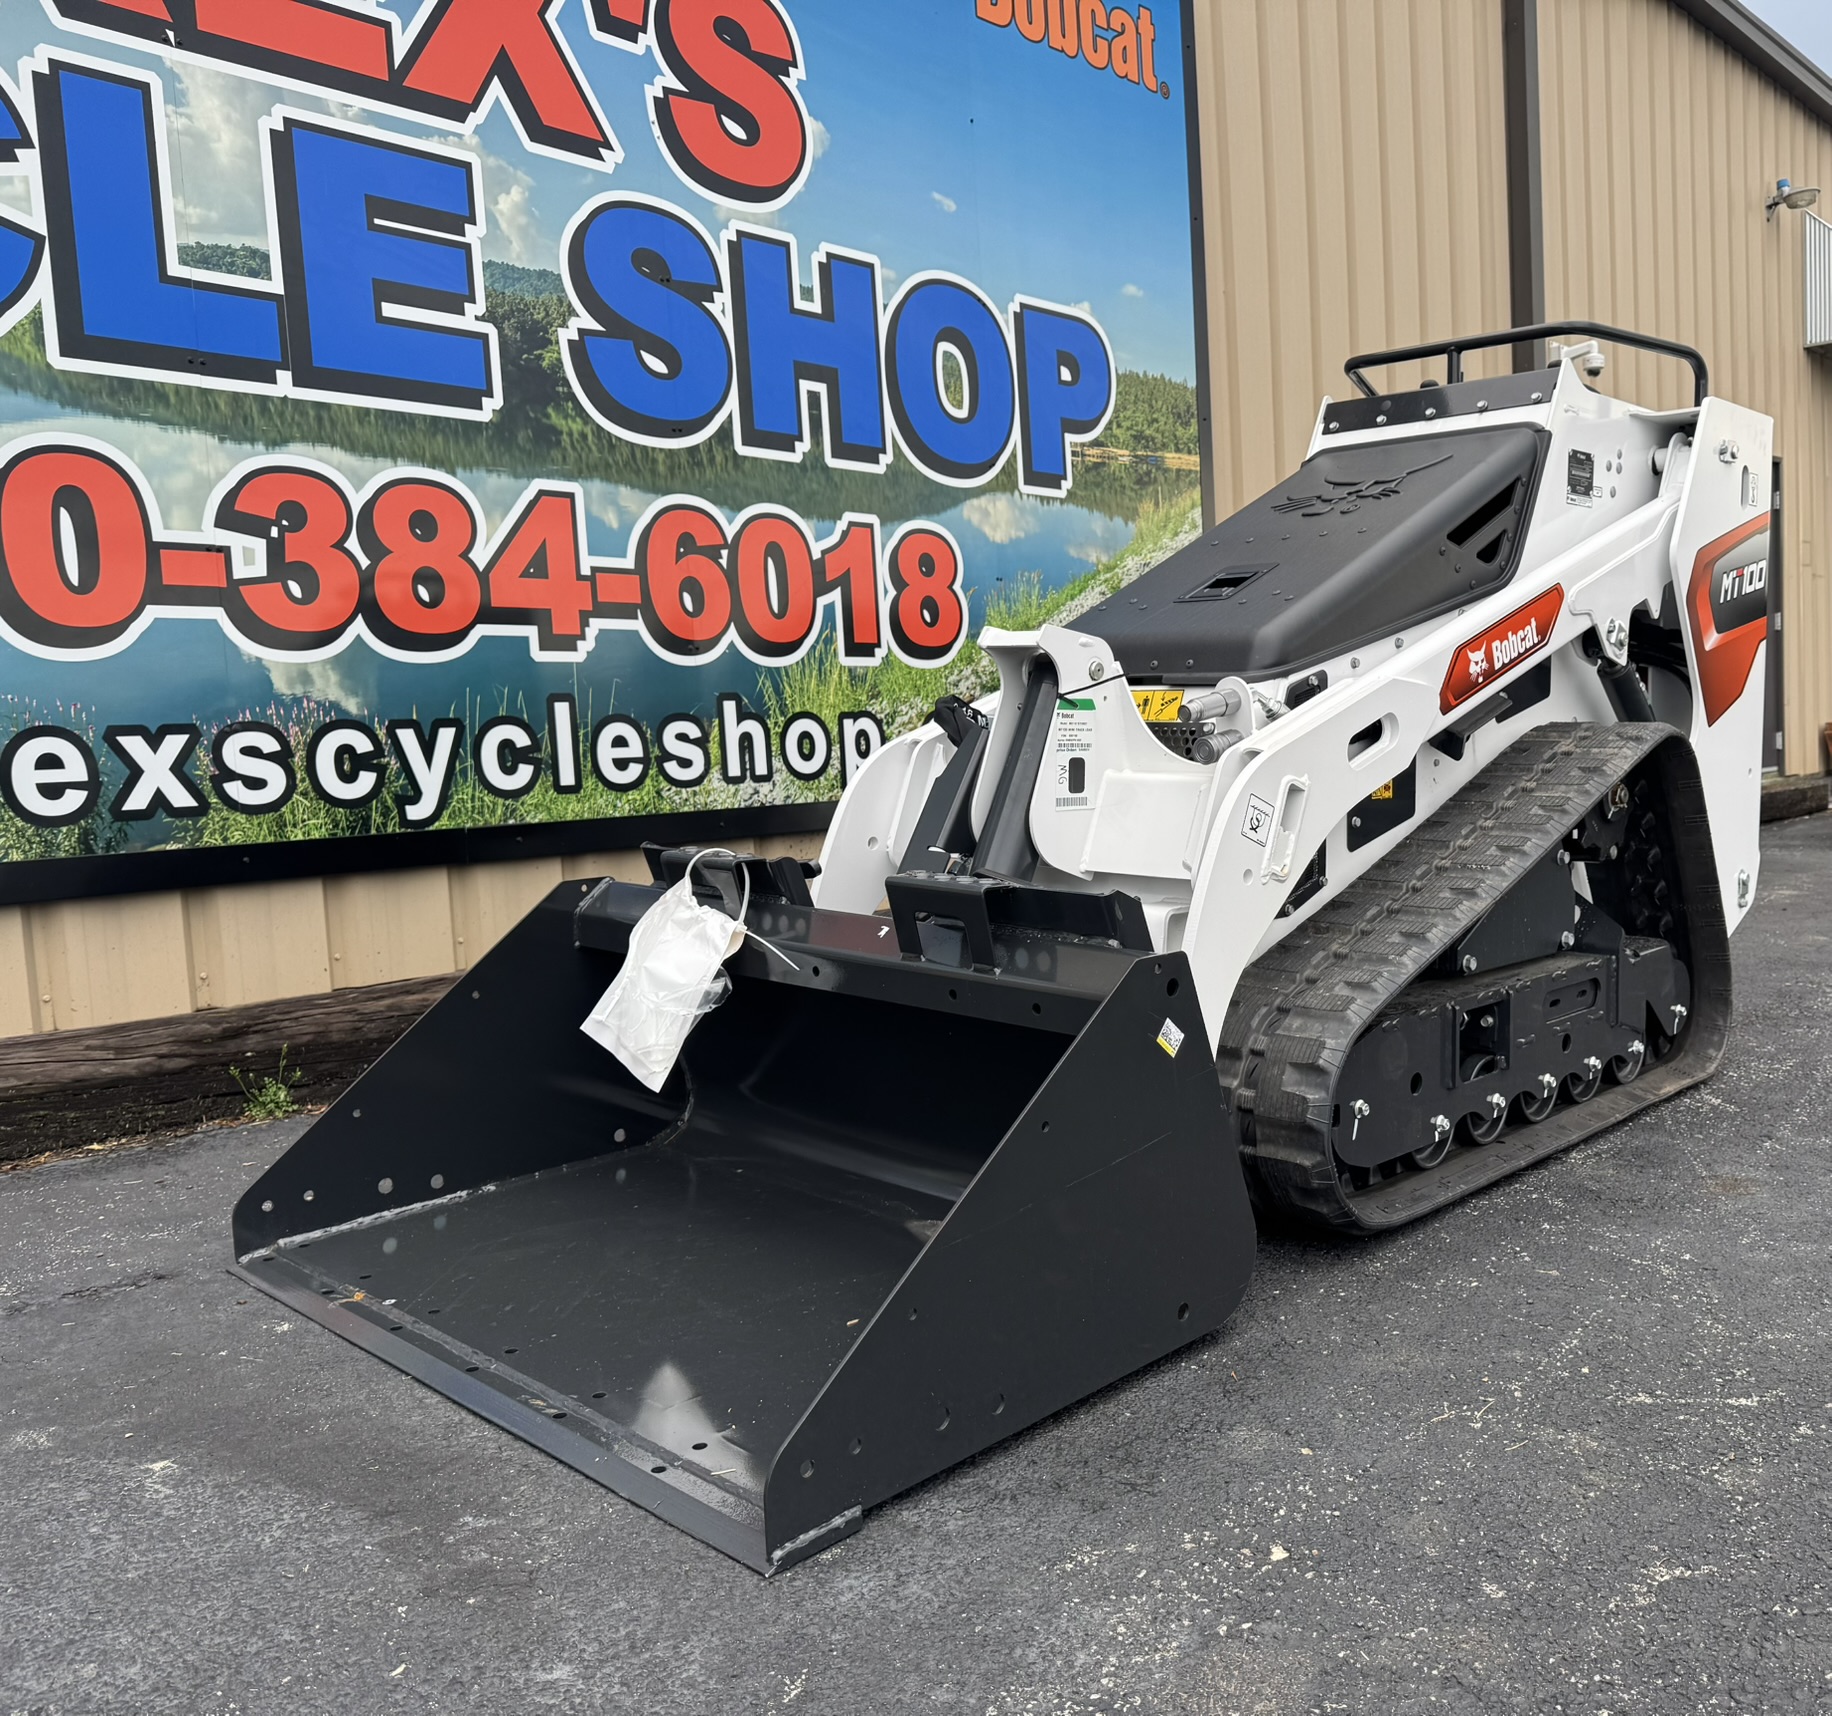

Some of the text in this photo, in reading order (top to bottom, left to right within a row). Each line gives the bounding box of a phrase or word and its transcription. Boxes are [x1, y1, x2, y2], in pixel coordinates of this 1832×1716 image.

[974, 0, 1158, 94] obcat
[564, 200, 1112, 488] SHOP
[0, 446, 963, 655] 0-384-6018
[1719, 558, 1767, 604] MT100
[1491, 616, 1539, 671] Bobcat
